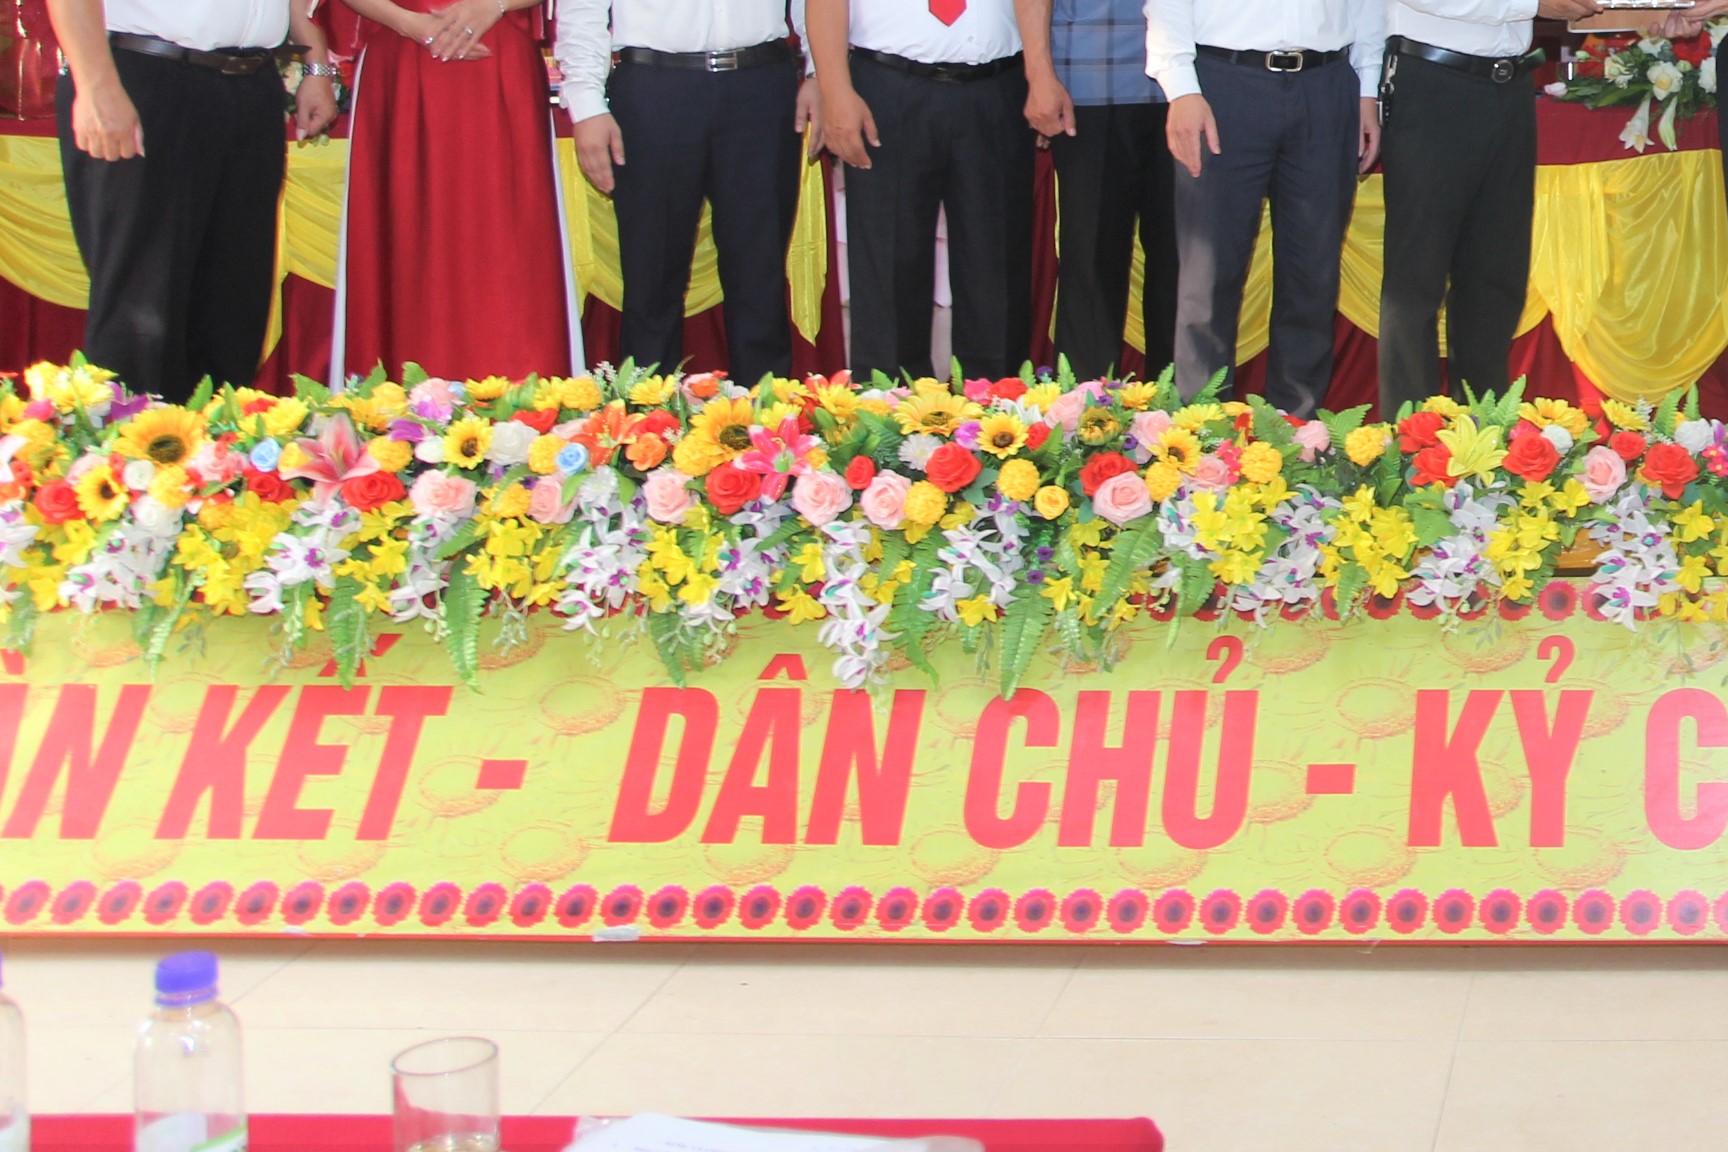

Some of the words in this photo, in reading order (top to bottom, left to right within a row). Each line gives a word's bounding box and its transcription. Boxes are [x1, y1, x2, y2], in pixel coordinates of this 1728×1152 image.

[154, 633, 453, 841] KẾT
[607, 652, 927, 846] DÂN
[963, 634, 1259, 849] CHỦ
[1407, 634, 1595, 848] KỶ
